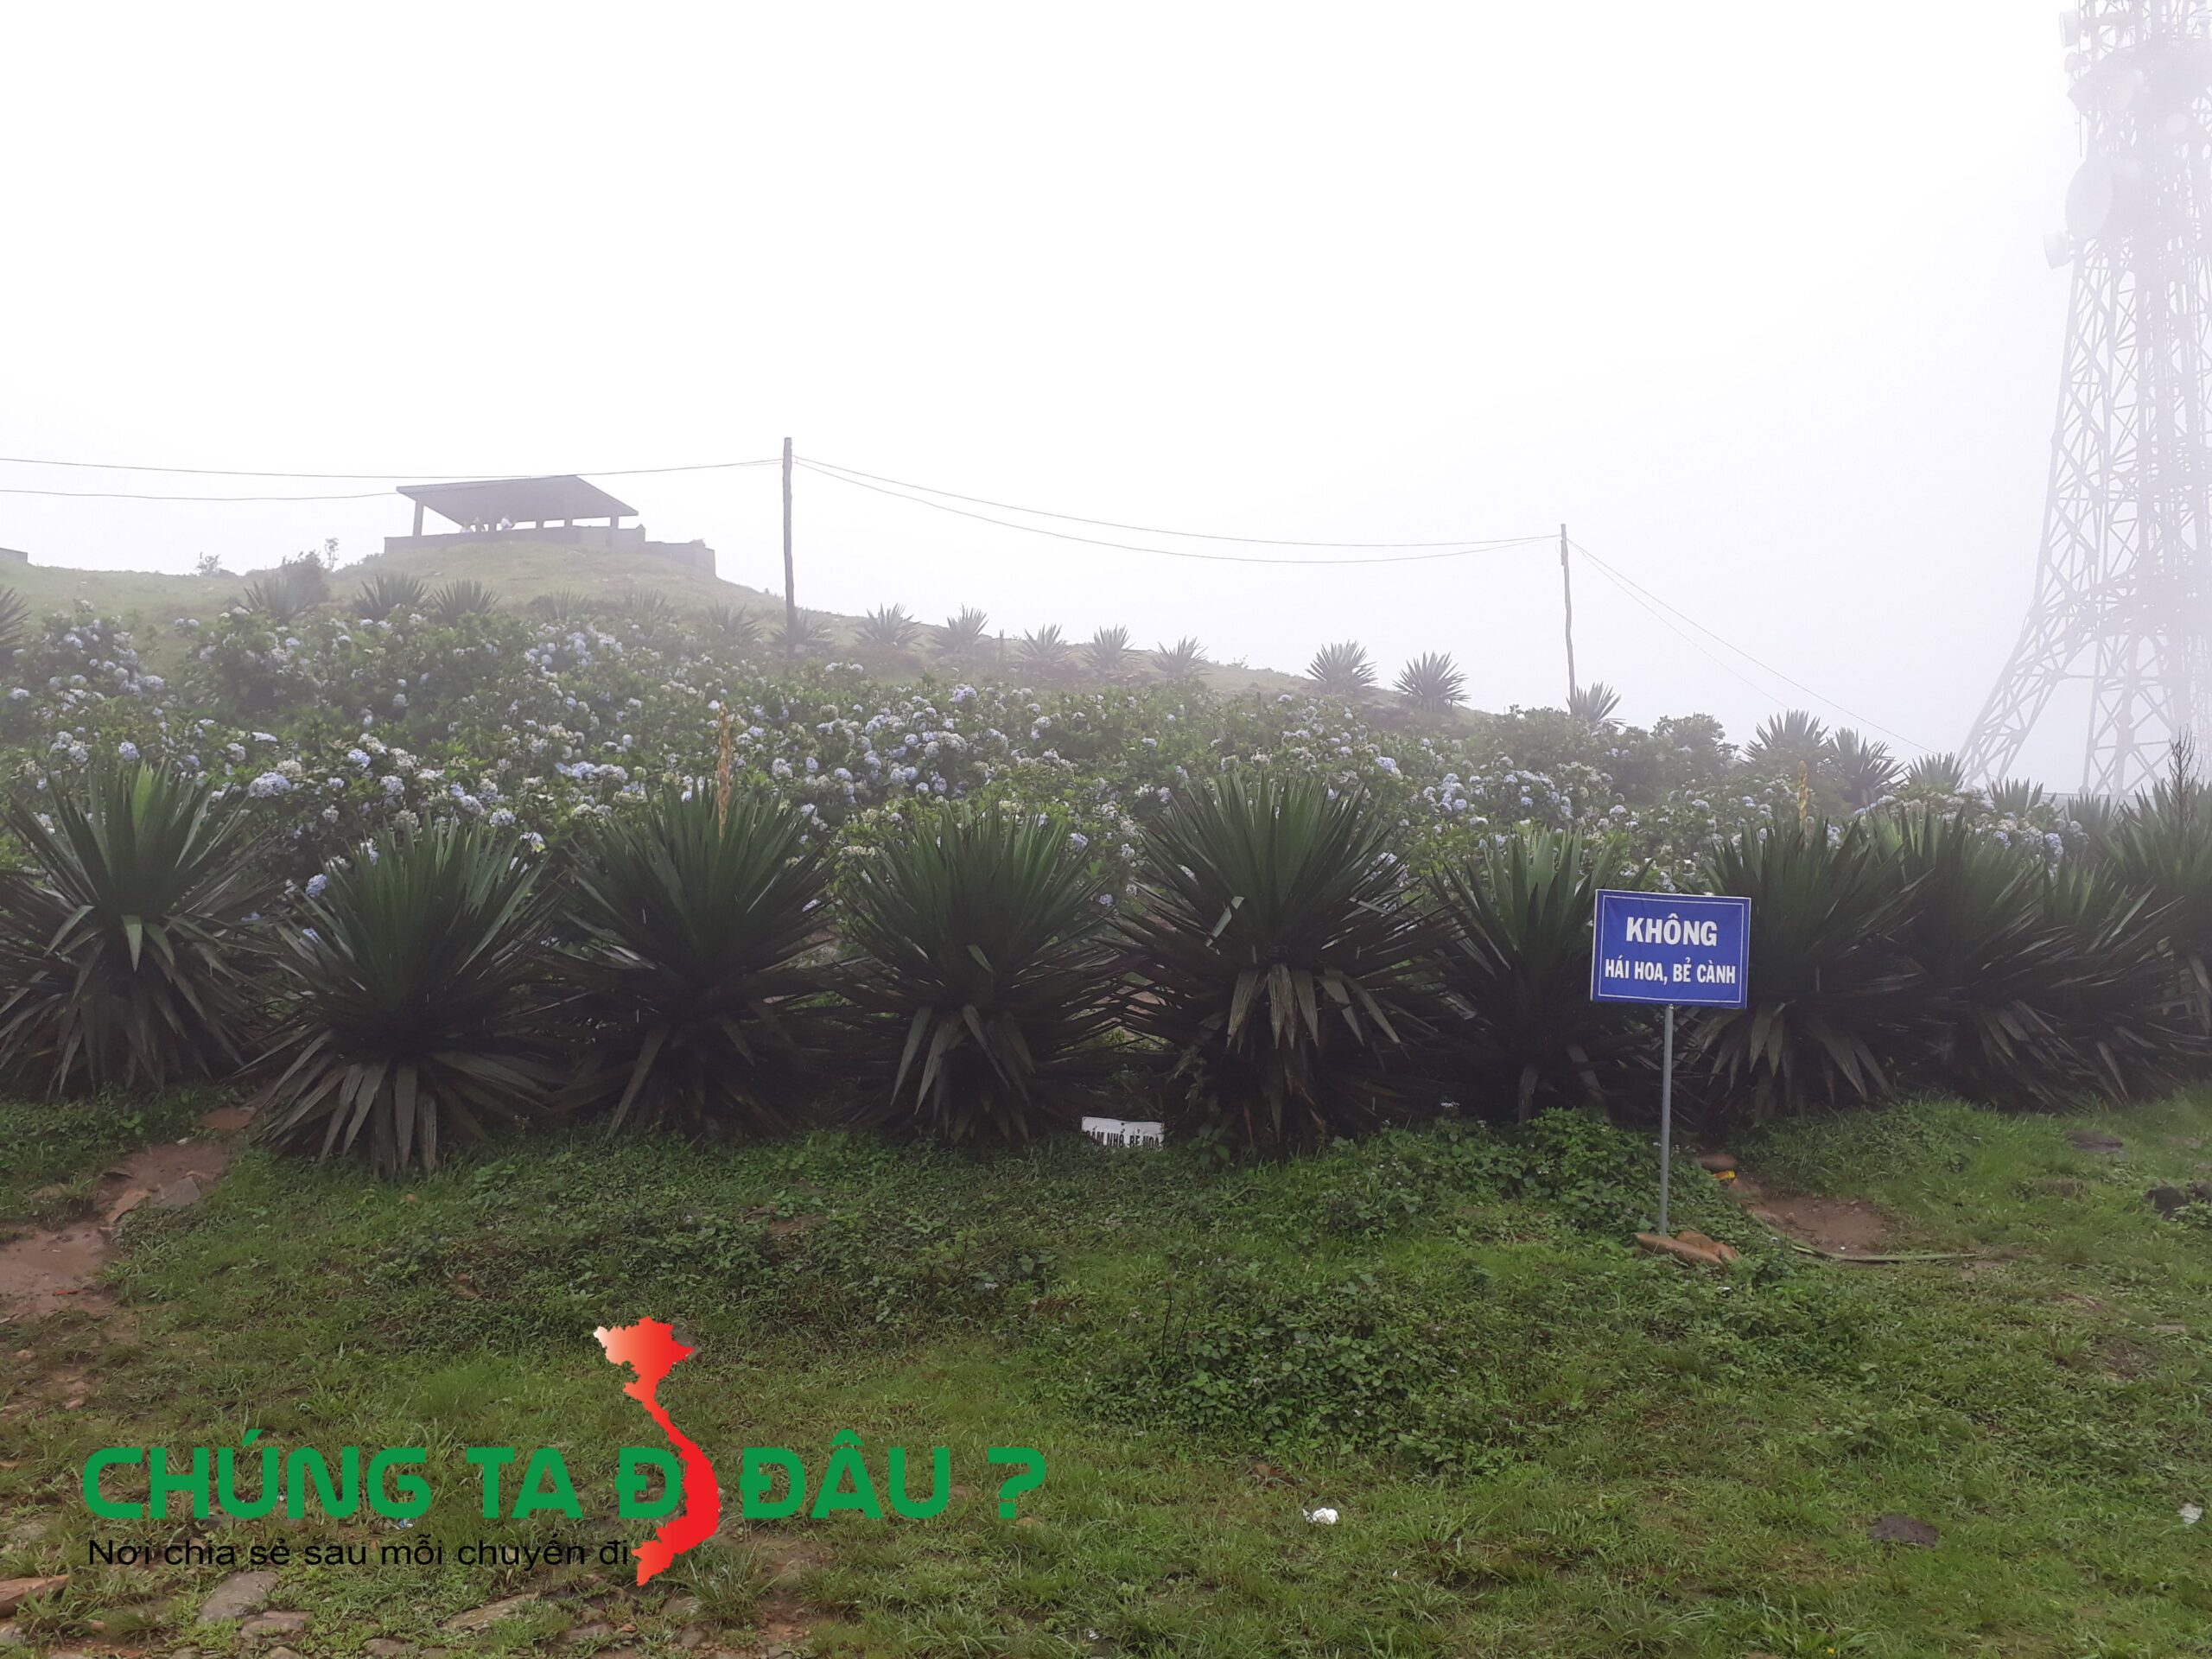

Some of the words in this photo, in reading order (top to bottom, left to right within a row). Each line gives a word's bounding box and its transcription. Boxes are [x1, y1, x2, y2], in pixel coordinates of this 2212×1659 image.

[1625, 912, 1718, 947] KHÔNG
[1605, 955, 1630, 978] HÁI
[1634, 961, 1668, 985] HOA,
[1673, 957, 1692, 982] BẺ
[1696, 960, 1736, 984] CÀNH
